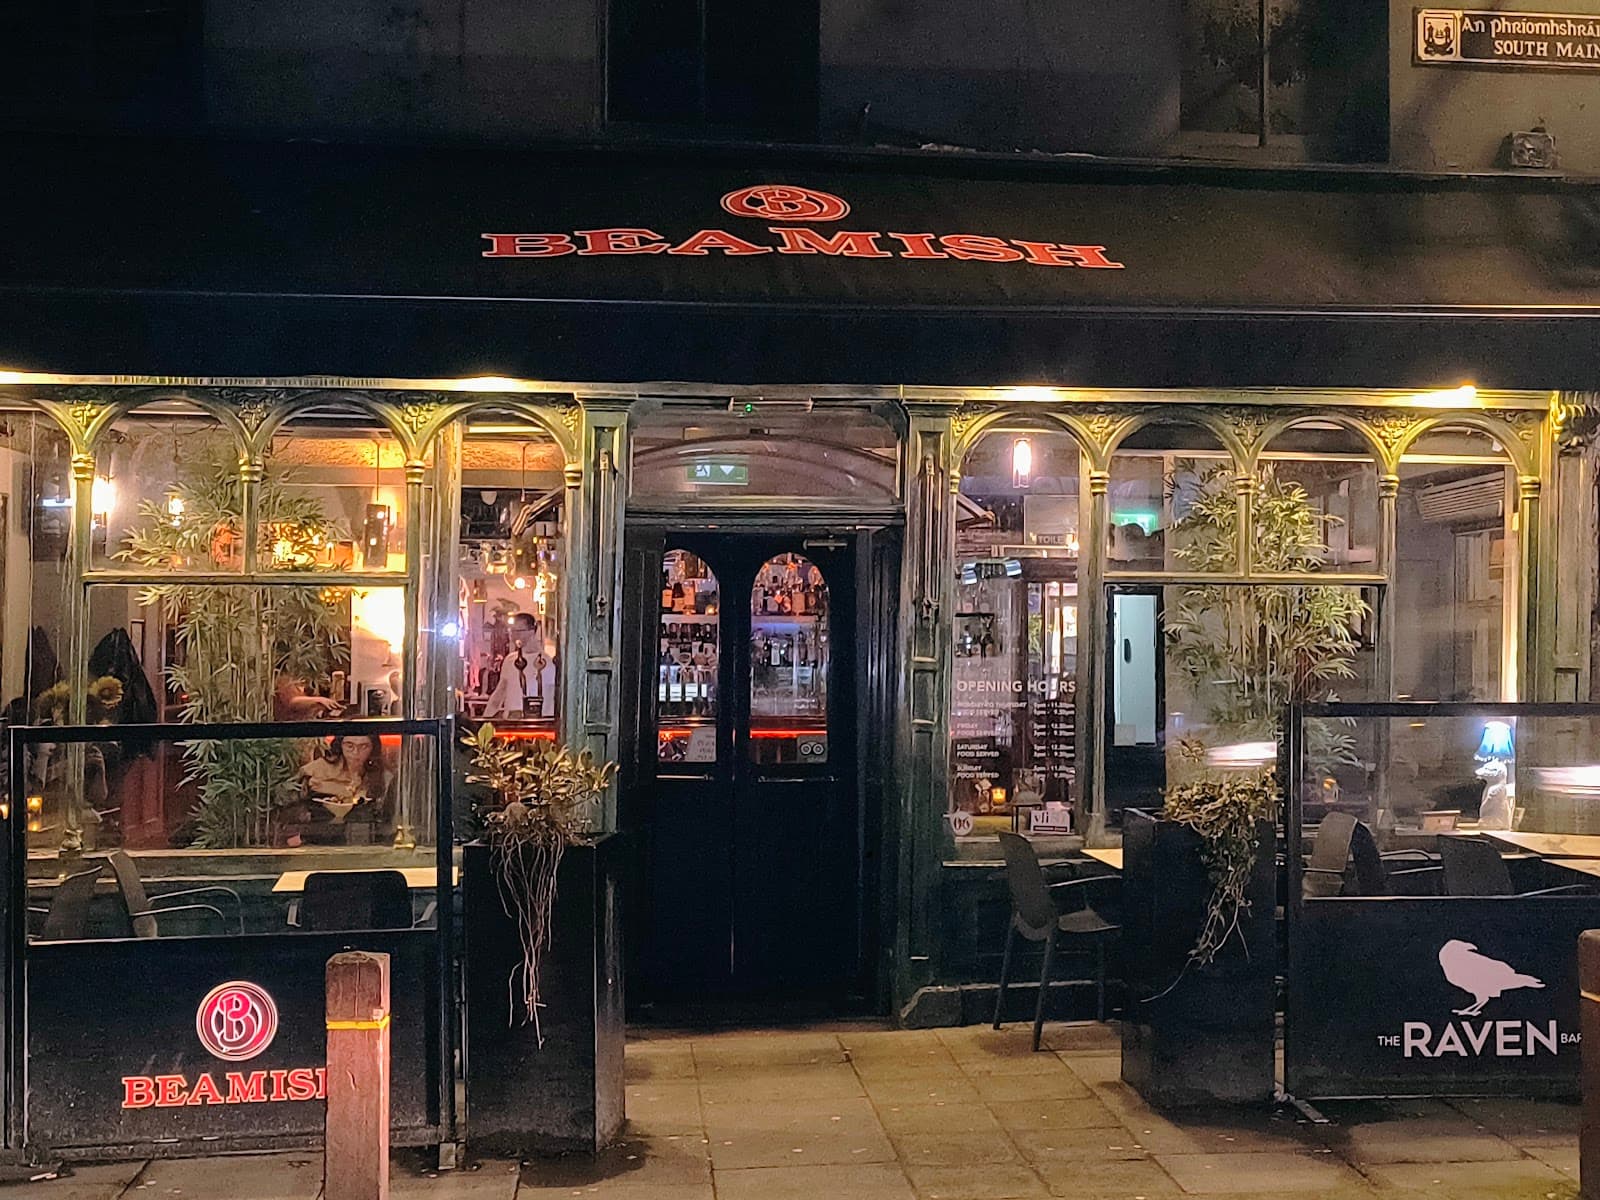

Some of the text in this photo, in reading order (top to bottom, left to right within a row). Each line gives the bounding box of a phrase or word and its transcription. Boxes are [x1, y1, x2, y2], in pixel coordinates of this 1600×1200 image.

[1462, 17, 1485, 32] An
[1494, 40, 1548, 57] SOUTH
[481, 227, 1125, 269] BEAMISH
[957, 680, 1076, 692] OPENING HORS
[1377, 1035, 1401, 1047] THE
[1403, 1020, 1558, 1057] RAVEN
